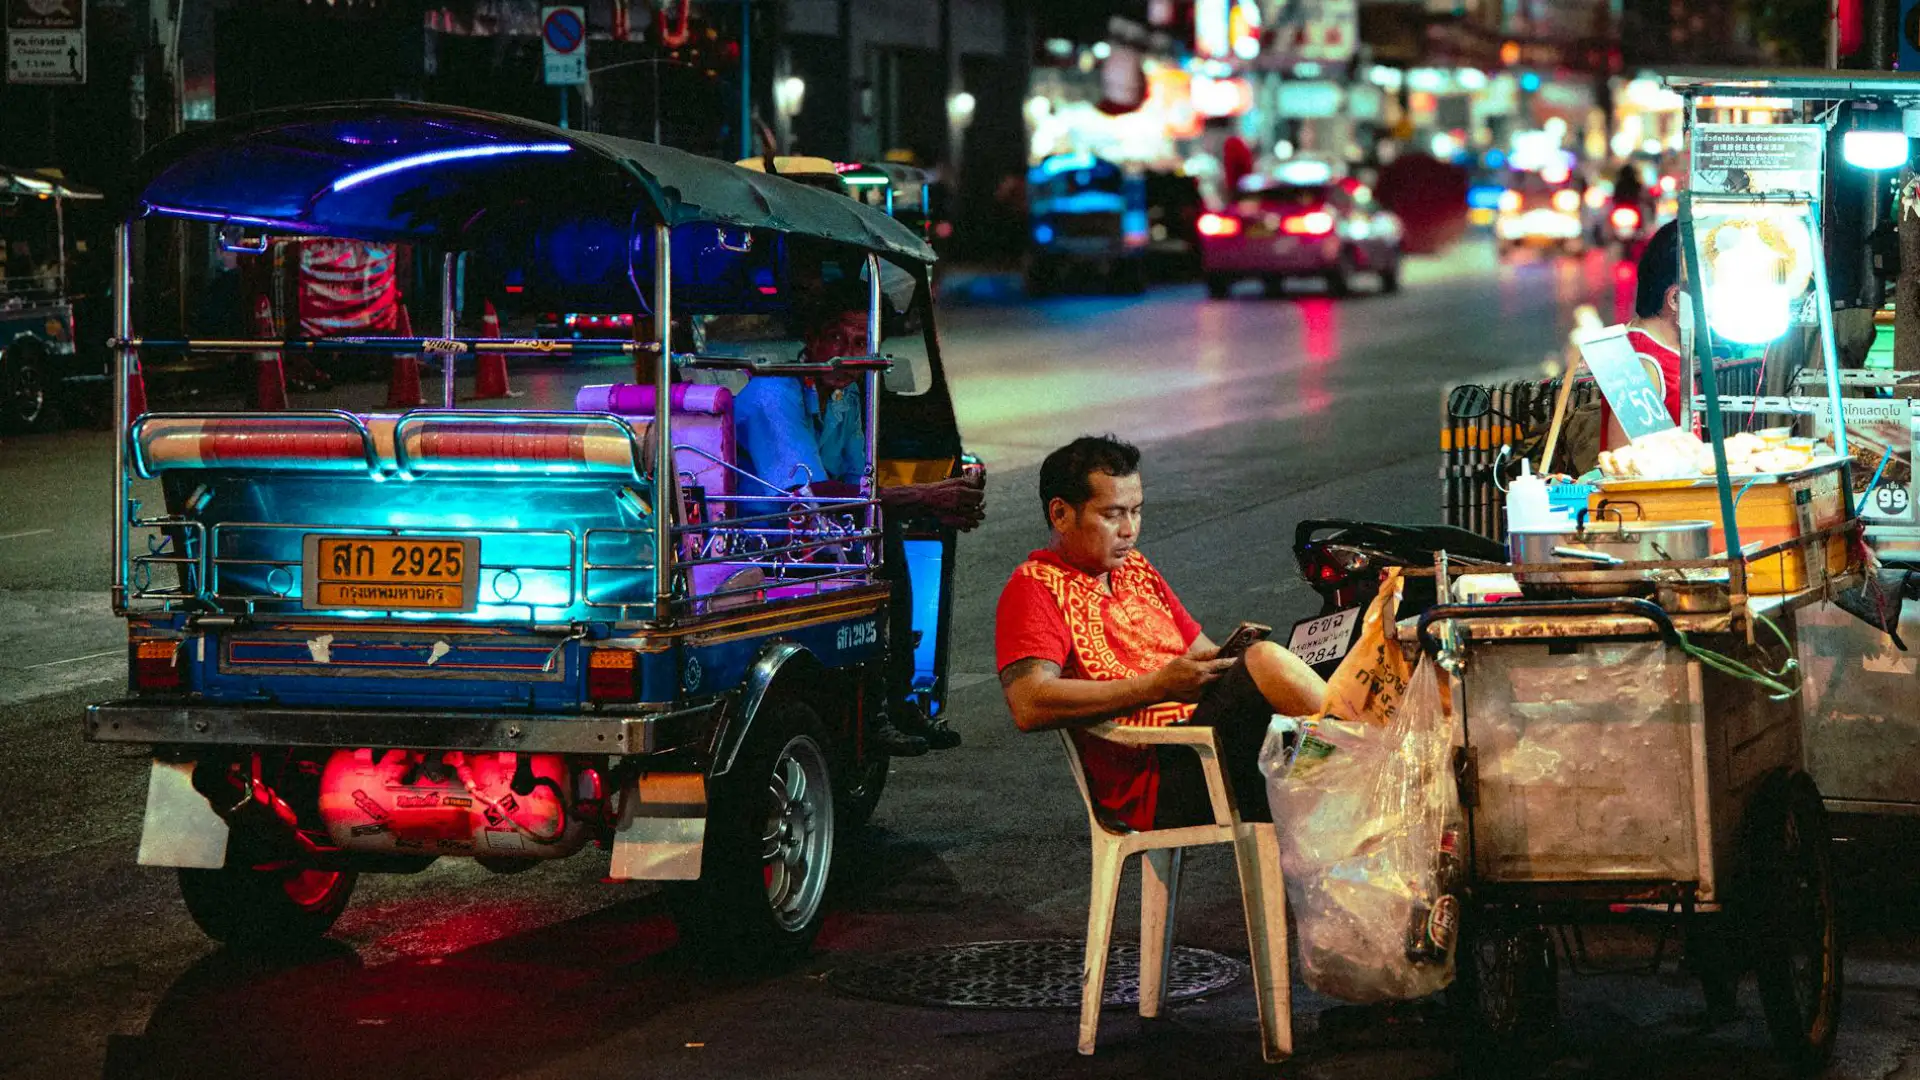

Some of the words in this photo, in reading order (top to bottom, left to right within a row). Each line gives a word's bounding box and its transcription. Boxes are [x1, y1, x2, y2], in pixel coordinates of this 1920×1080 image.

[1879, 489, 1906, 508] 99
[333, 543, 375, 576] สก
[391, 546, 462, 577] 2925
[340, 585, 444, 604] กรุงเทพมหานคร
[853, 620, 877, 646] 2925
[1299, 644, 1337, 665] 284
